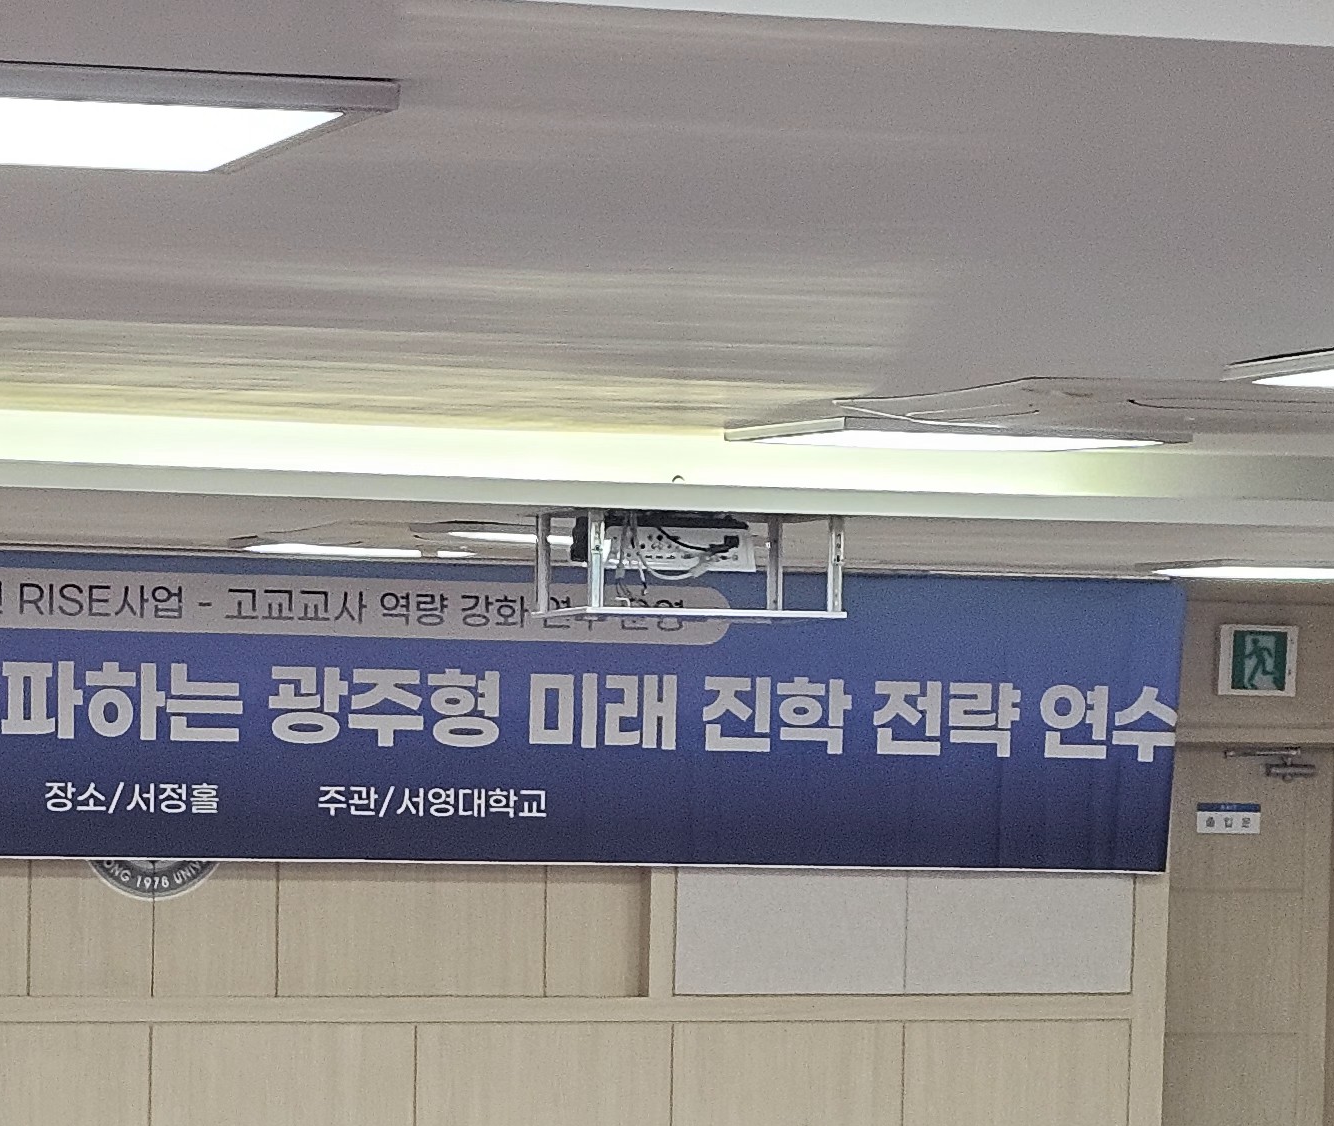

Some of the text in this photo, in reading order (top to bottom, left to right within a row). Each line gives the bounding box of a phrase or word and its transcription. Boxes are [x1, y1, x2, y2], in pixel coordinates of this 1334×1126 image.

[19, 583, 183, 619] RISE사업
[225, 588, 367, 623] 고교교사
[380, 592, 449, 626] 역량
[461, 595, 528, 628] 강화
[269, 665, 500, 748] 광주형
[529, 672, 678, 751] 미래
[703, 676, 853, 756] 진학
[872, 679, 1020, 758] 전략
[1040, 684, 1178, 763] 연수
[44, 782, 219, 814] 장소/서정홀
[317, 785, 547, 818] 주관/서영대학교
